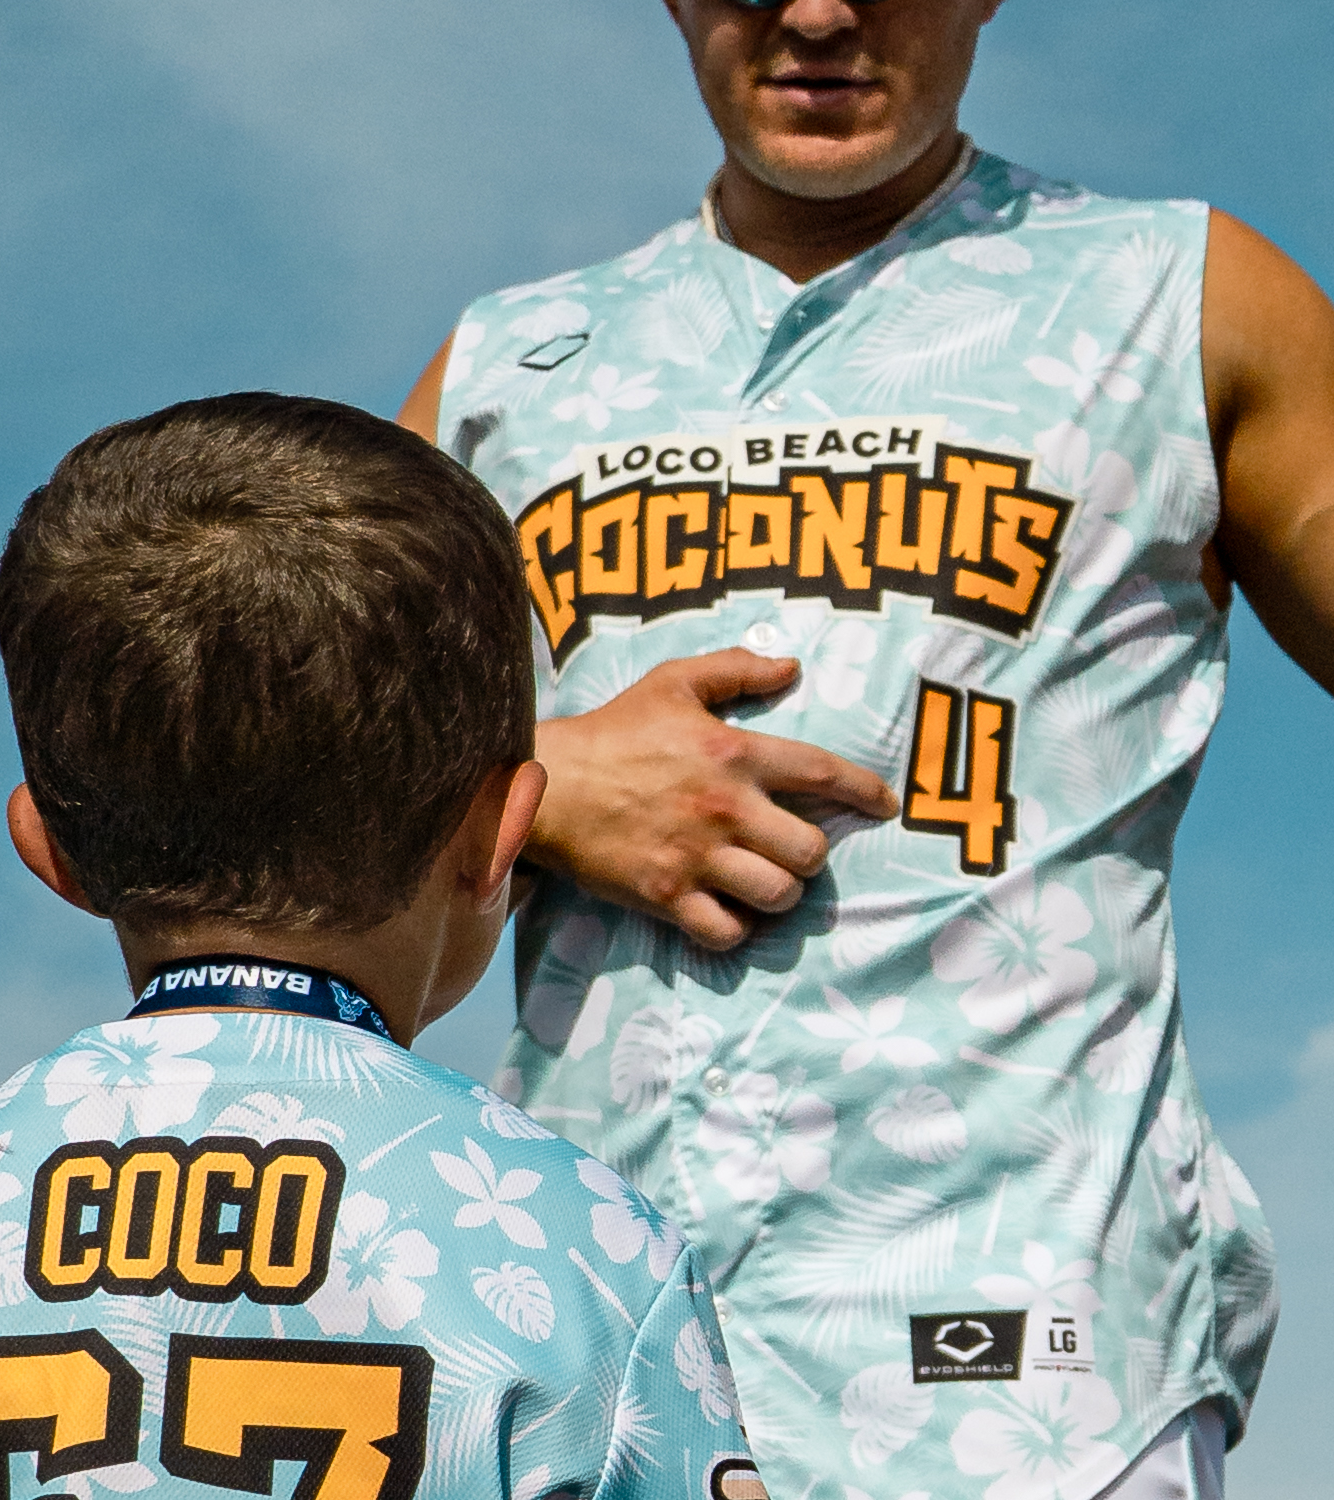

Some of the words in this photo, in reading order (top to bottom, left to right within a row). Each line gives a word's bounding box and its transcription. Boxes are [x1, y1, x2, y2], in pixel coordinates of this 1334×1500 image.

[596, 443, 724, 480] LOCO
[744, 427, 924, 467] BEACH
[515, 453, 1061, 653] COCONUTS
[906, 685, 1010, 869] 4
[164, 964, 314, 996] BANANA
[35, 1145, 336, 1295] COCO
[1048, 1328, 1077, 1354] LG
